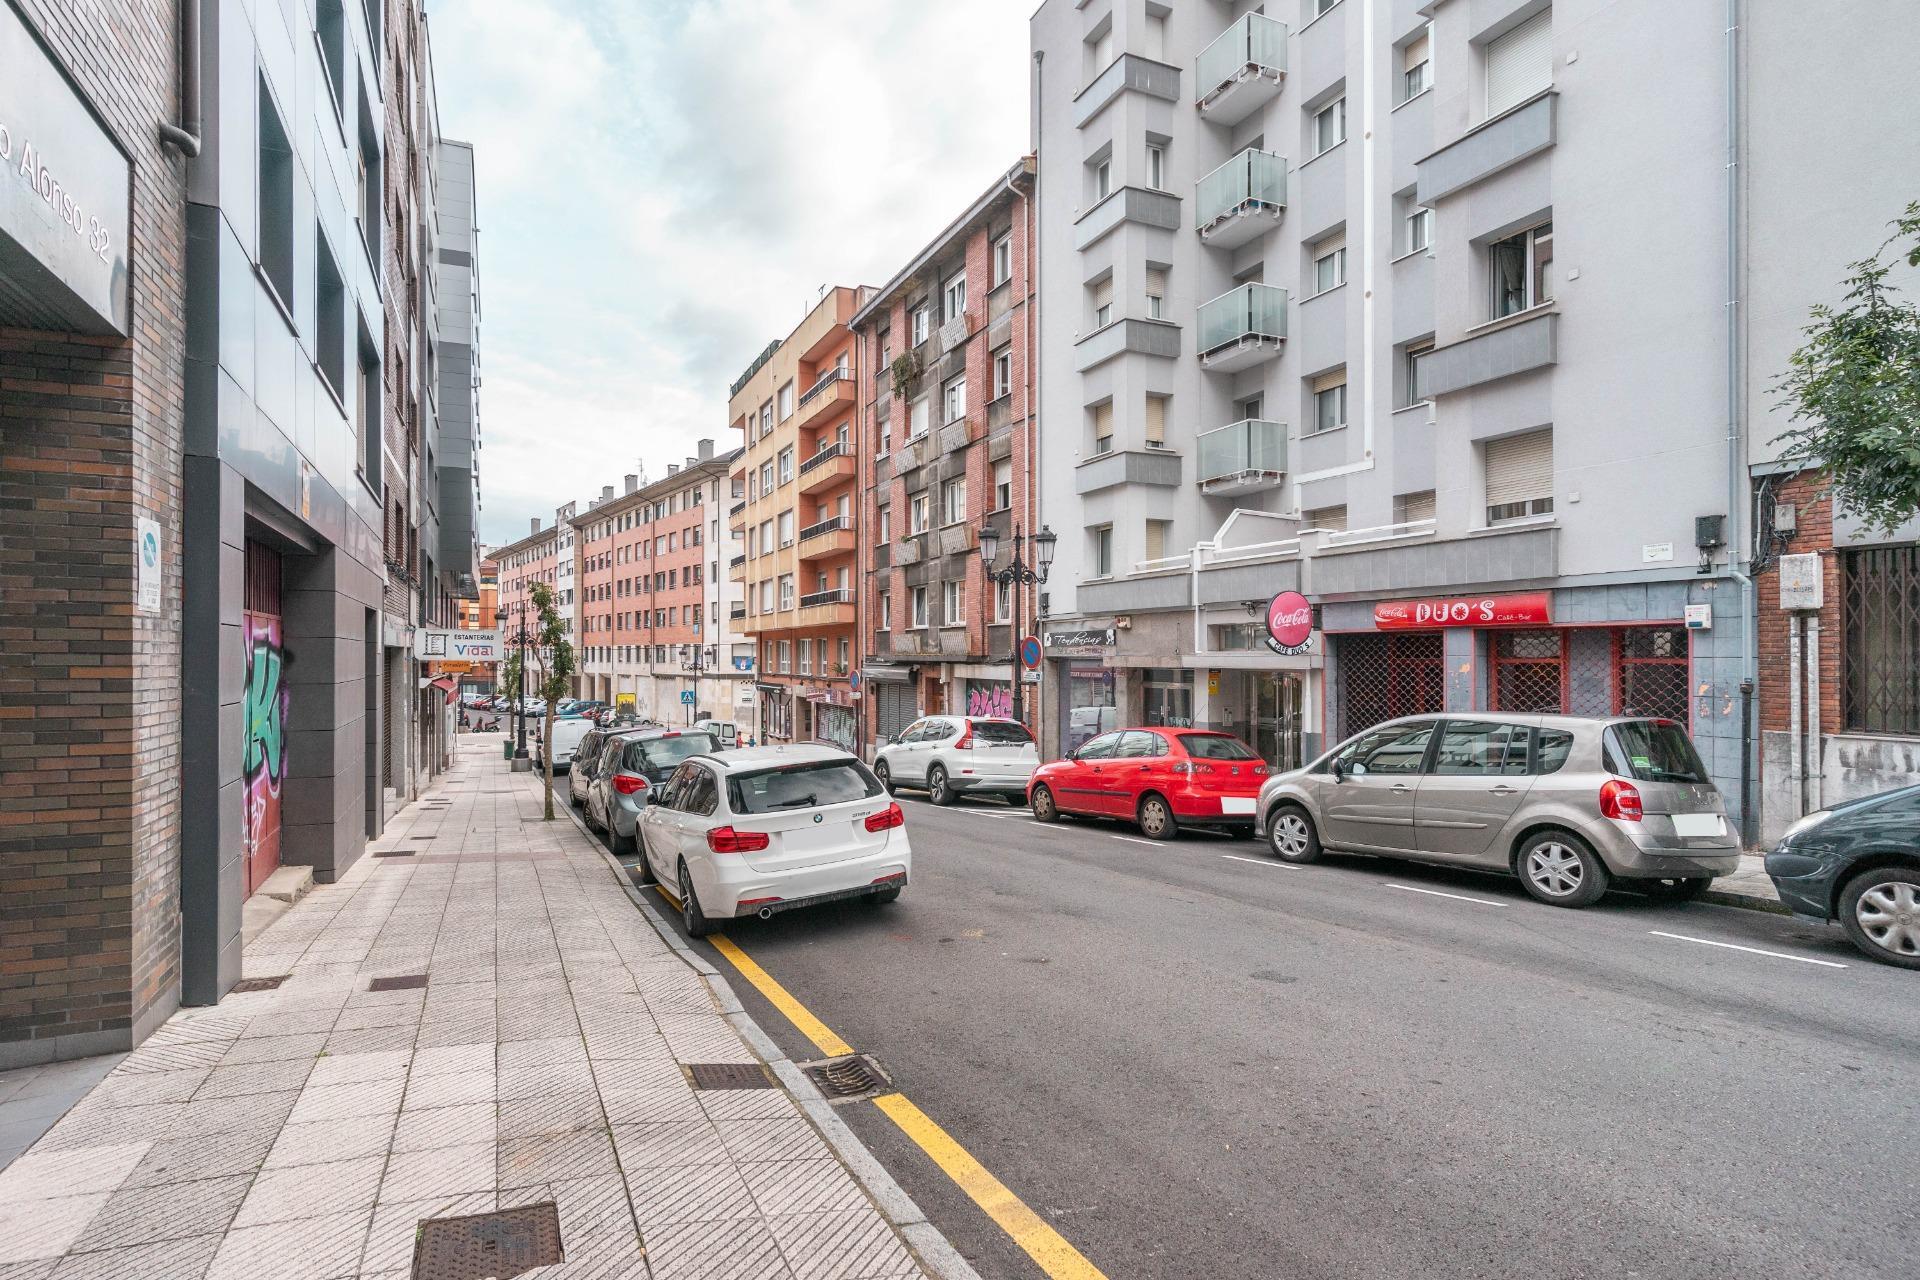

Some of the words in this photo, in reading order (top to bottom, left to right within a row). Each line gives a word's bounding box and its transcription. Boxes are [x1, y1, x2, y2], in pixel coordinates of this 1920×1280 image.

[19, 140, 83, 235] Alonso
[90, 215, 109, 264] 32
[1273, 607, 1310, 628] Coca-Cola
[1379, 606, 1407, 618] Coca-Cola
[1054, 631, 1102, 646] Tendencias
[454, 644, 494, 656] Vidal
